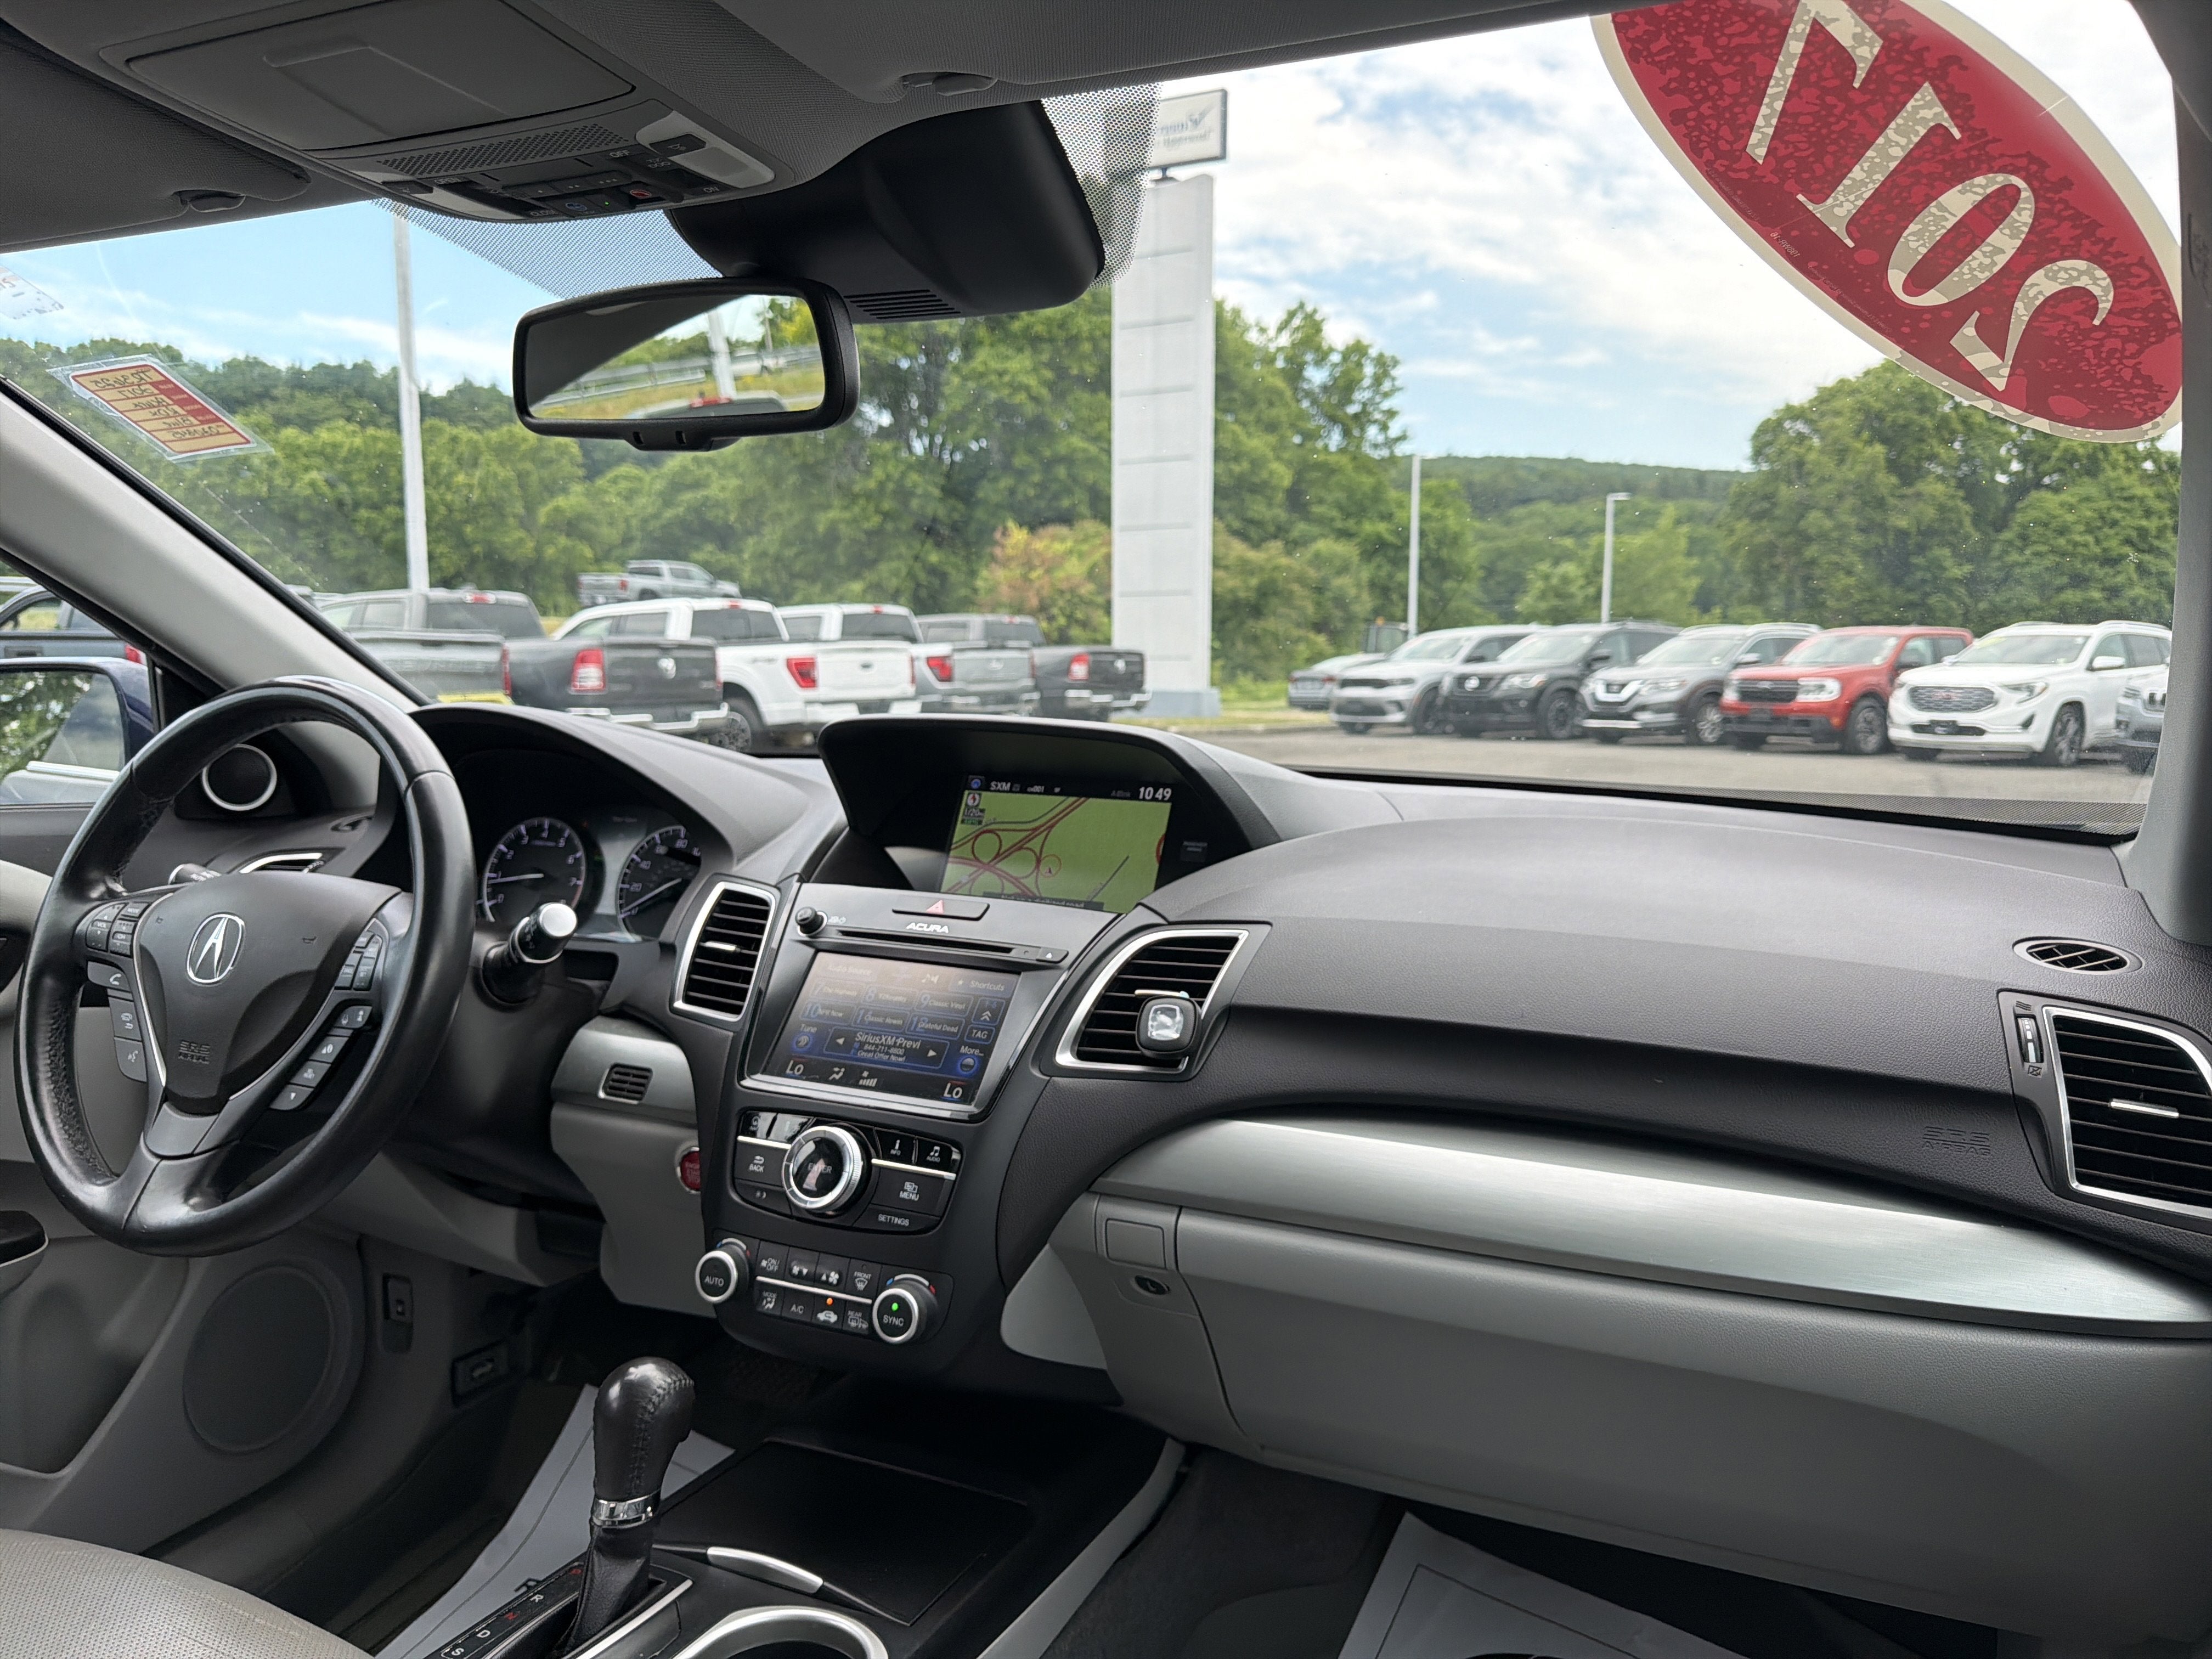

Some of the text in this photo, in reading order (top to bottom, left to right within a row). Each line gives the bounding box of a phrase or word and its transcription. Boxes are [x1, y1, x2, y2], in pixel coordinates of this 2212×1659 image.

[989, 781, 1011, 791] SXM
[906, 922, 949, 934] ACURA
[969, 980, 1005, 991] Shortcuts
[921, 993, 931, 1009] 9
[799, 1023, 817, 1033] Tune
[918, 1020, 959, 1033] Grateful Dead
[971, 1029, 988, 1039] TAG
[857, 1049, 874, 1058] Great
[749, 1164, 764, 1173] BACK
[808, 1163, 832, 1173] ENER
[899, 1190, 919, 1201] MENU
[878, 1214, 910, 1227] SETTINGS
[766, 1263, 779, 1272] OFF
[704, 1275, 725, 1288] AUTO
[790, 1304, 805, 1314] A/C
[883, 1314, 904, 1327] SYNC
[529, 1594, 544, 1602] R
[476, 1629, 491, 1638] D
[451, 1647, 465, 1656] S
